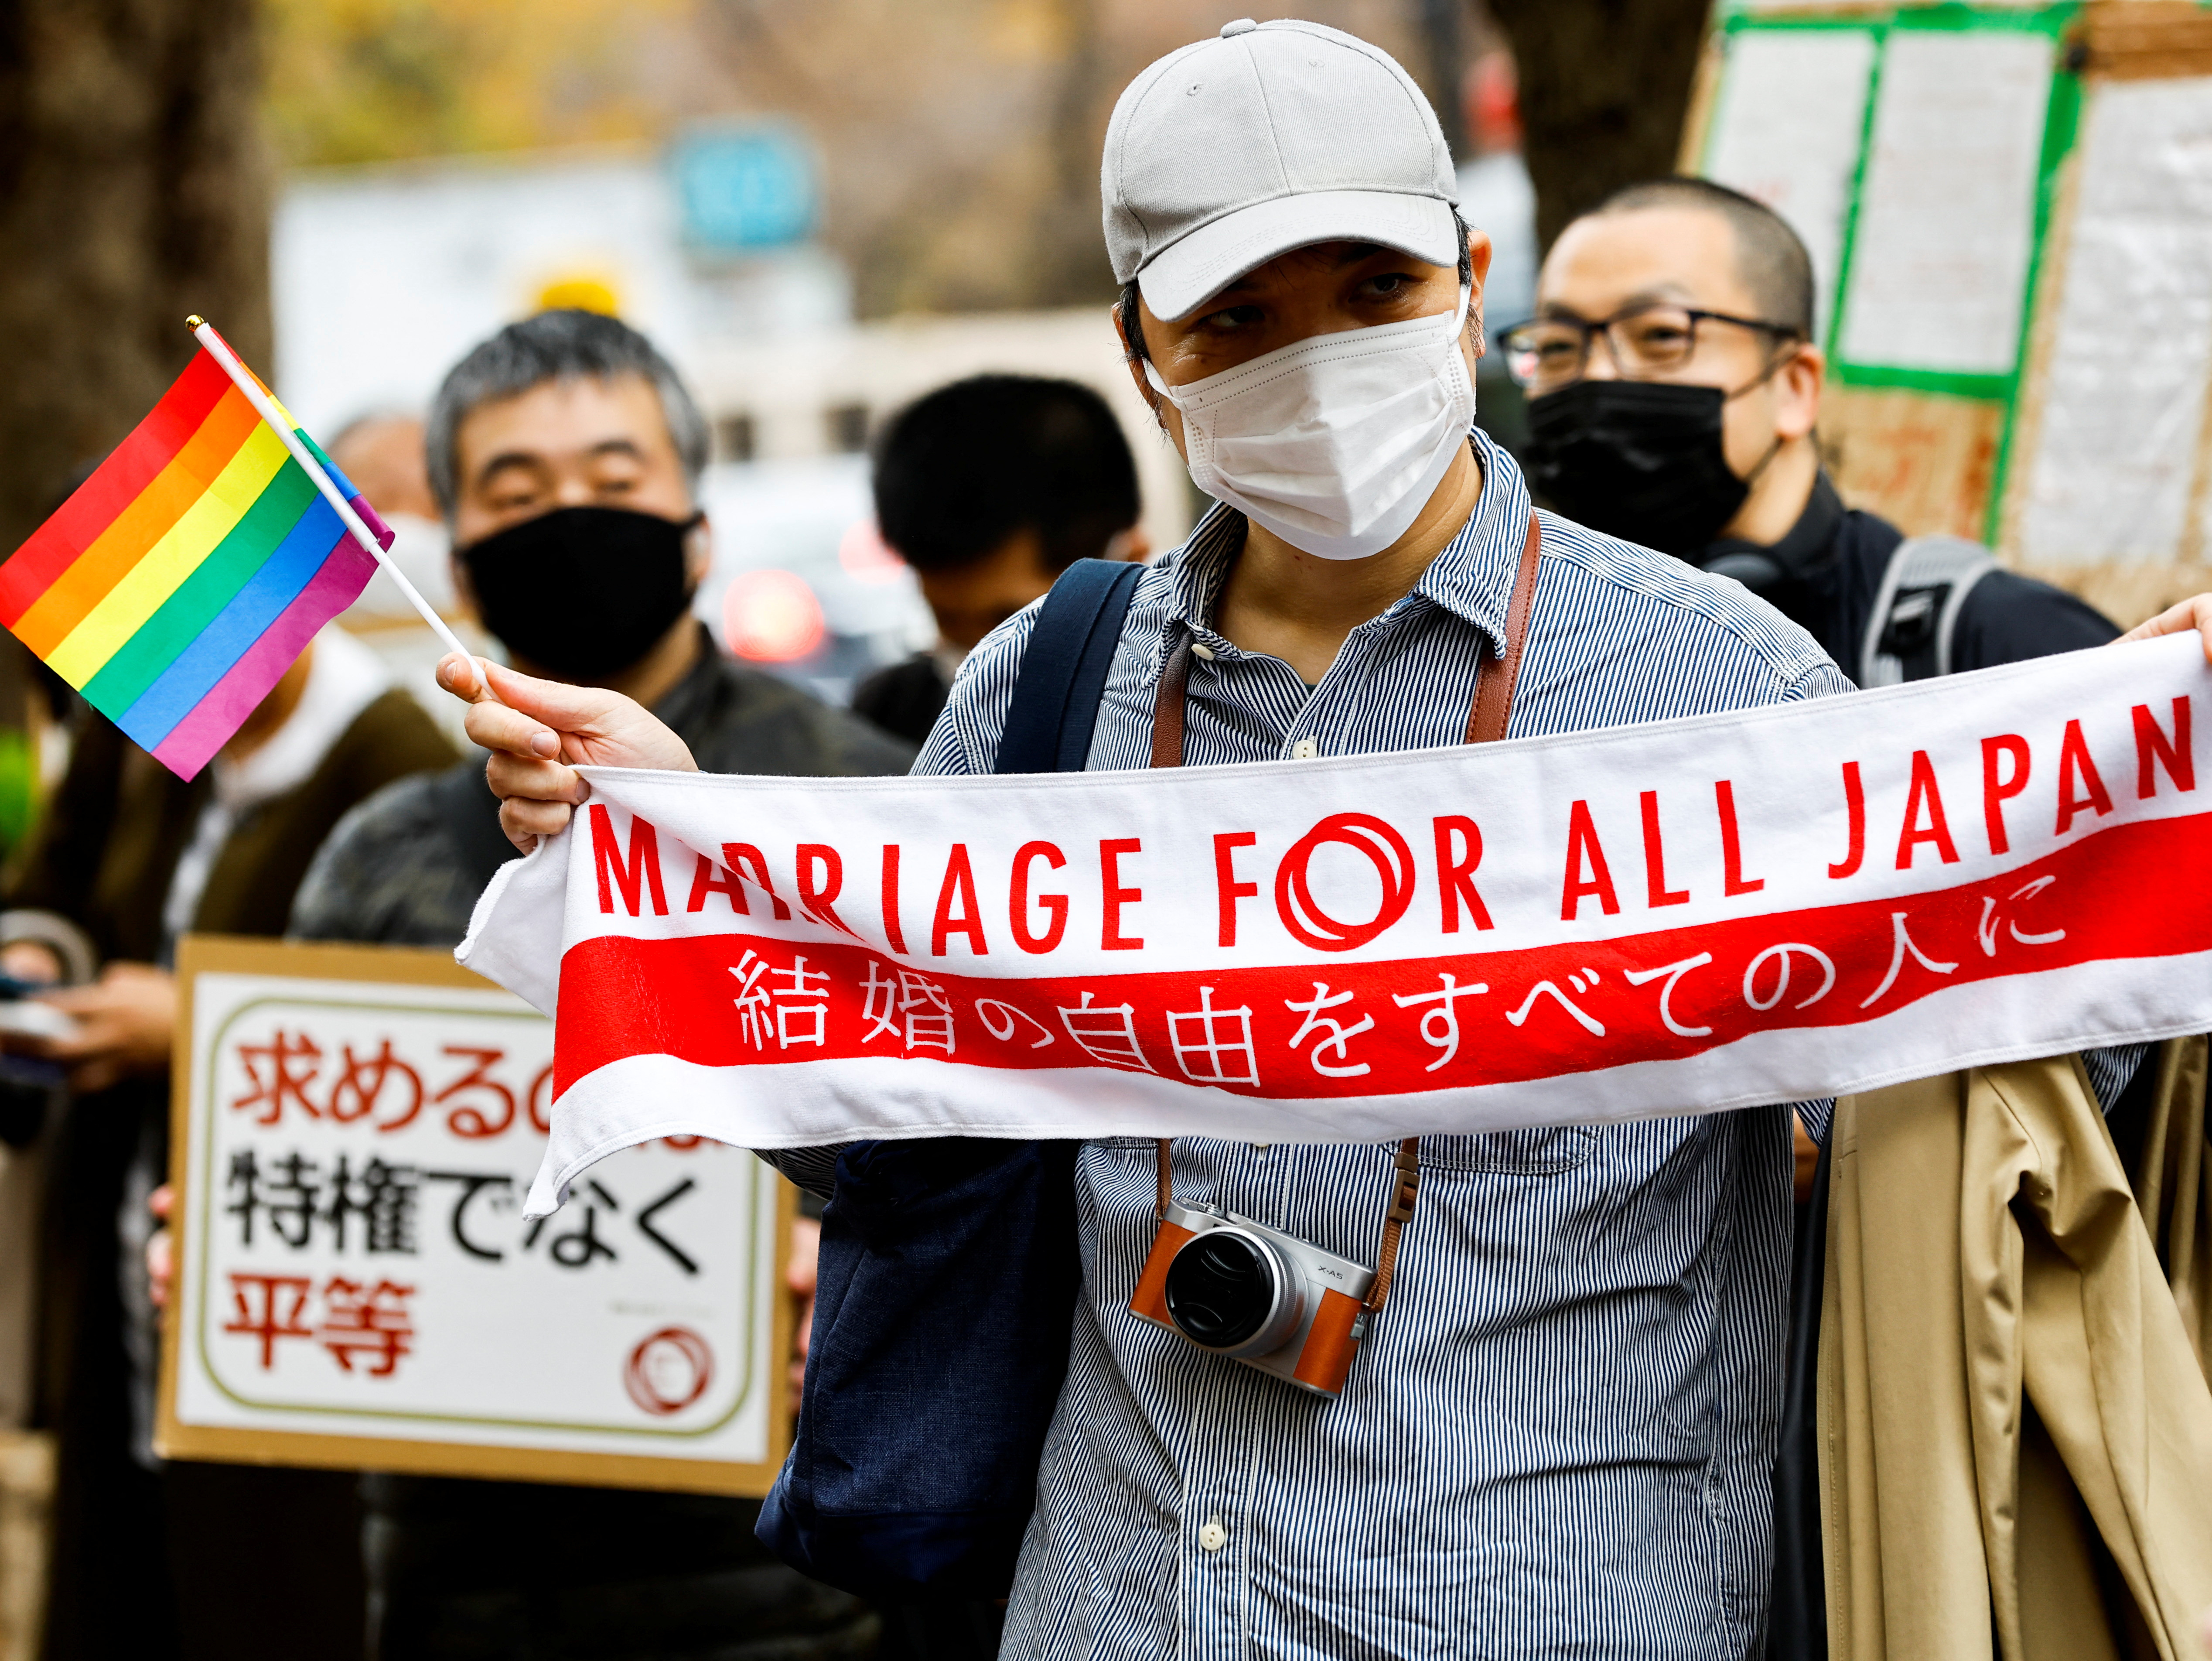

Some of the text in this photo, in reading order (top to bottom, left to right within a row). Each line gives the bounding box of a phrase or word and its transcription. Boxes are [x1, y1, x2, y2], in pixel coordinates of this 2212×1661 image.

[1213, 812, 1495, 953] FOR
[1560, 779, 1764, 921] ALL
[1828, 695, 2195, 879] JAPAN
[727, 875, 2066, 1088] 結婚の自由をすべての人に
[231, 1029, 726, 1152] 求める
[226, 1150, 700, 1277] 特権でなく
[1318, 1265, 1343, 1280] X-A5
[222, 1269, 416, 1378] 平等
